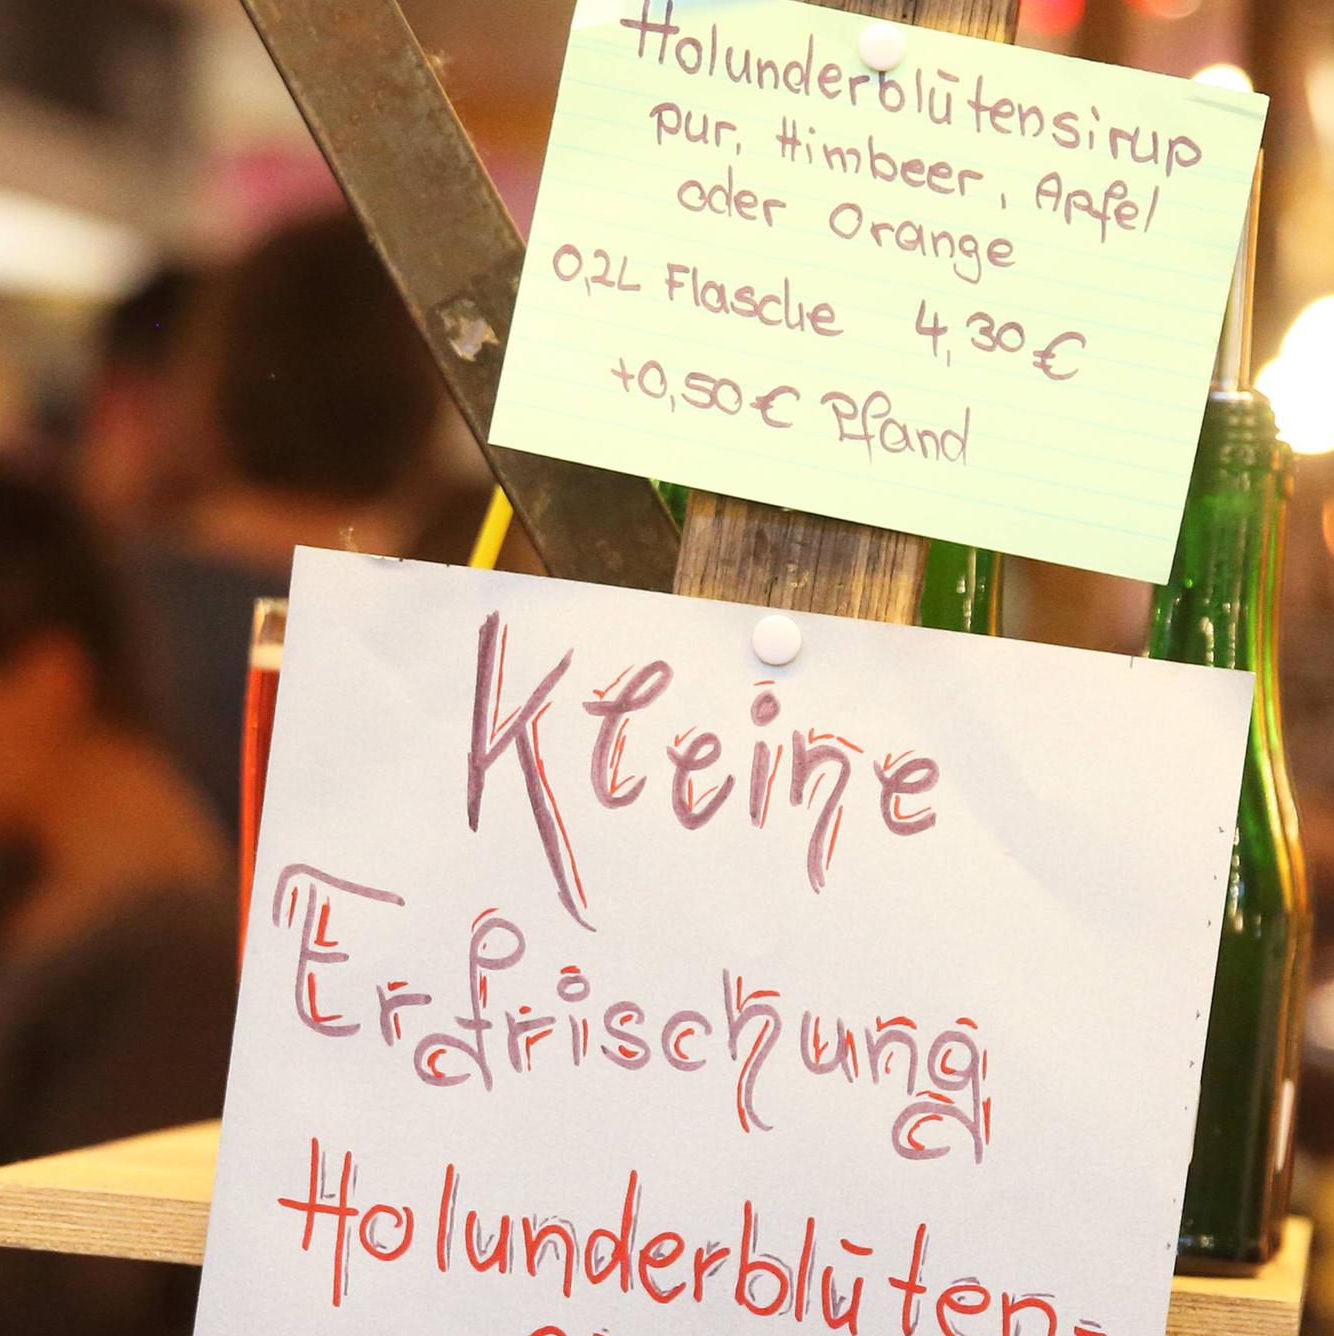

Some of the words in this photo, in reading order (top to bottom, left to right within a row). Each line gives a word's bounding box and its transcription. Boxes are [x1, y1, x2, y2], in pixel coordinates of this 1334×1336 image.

[620, 0, 1203, 176] Holunderblütensirup
[648, 102, 742, 157] pur,
[1035, 173, 1160, 243] Apfel
[677, 166, 787, 228] oder
[829, 202, 1015, 284] Orange
[552, 243, 641, 297] 0,2L
[665, 264, 845, 338] Flasche
[820, 392, 972, 467] Pfand
[467, 611, 939, 933] Kleine
[271, 864, 992, 1165] Erfrischung
